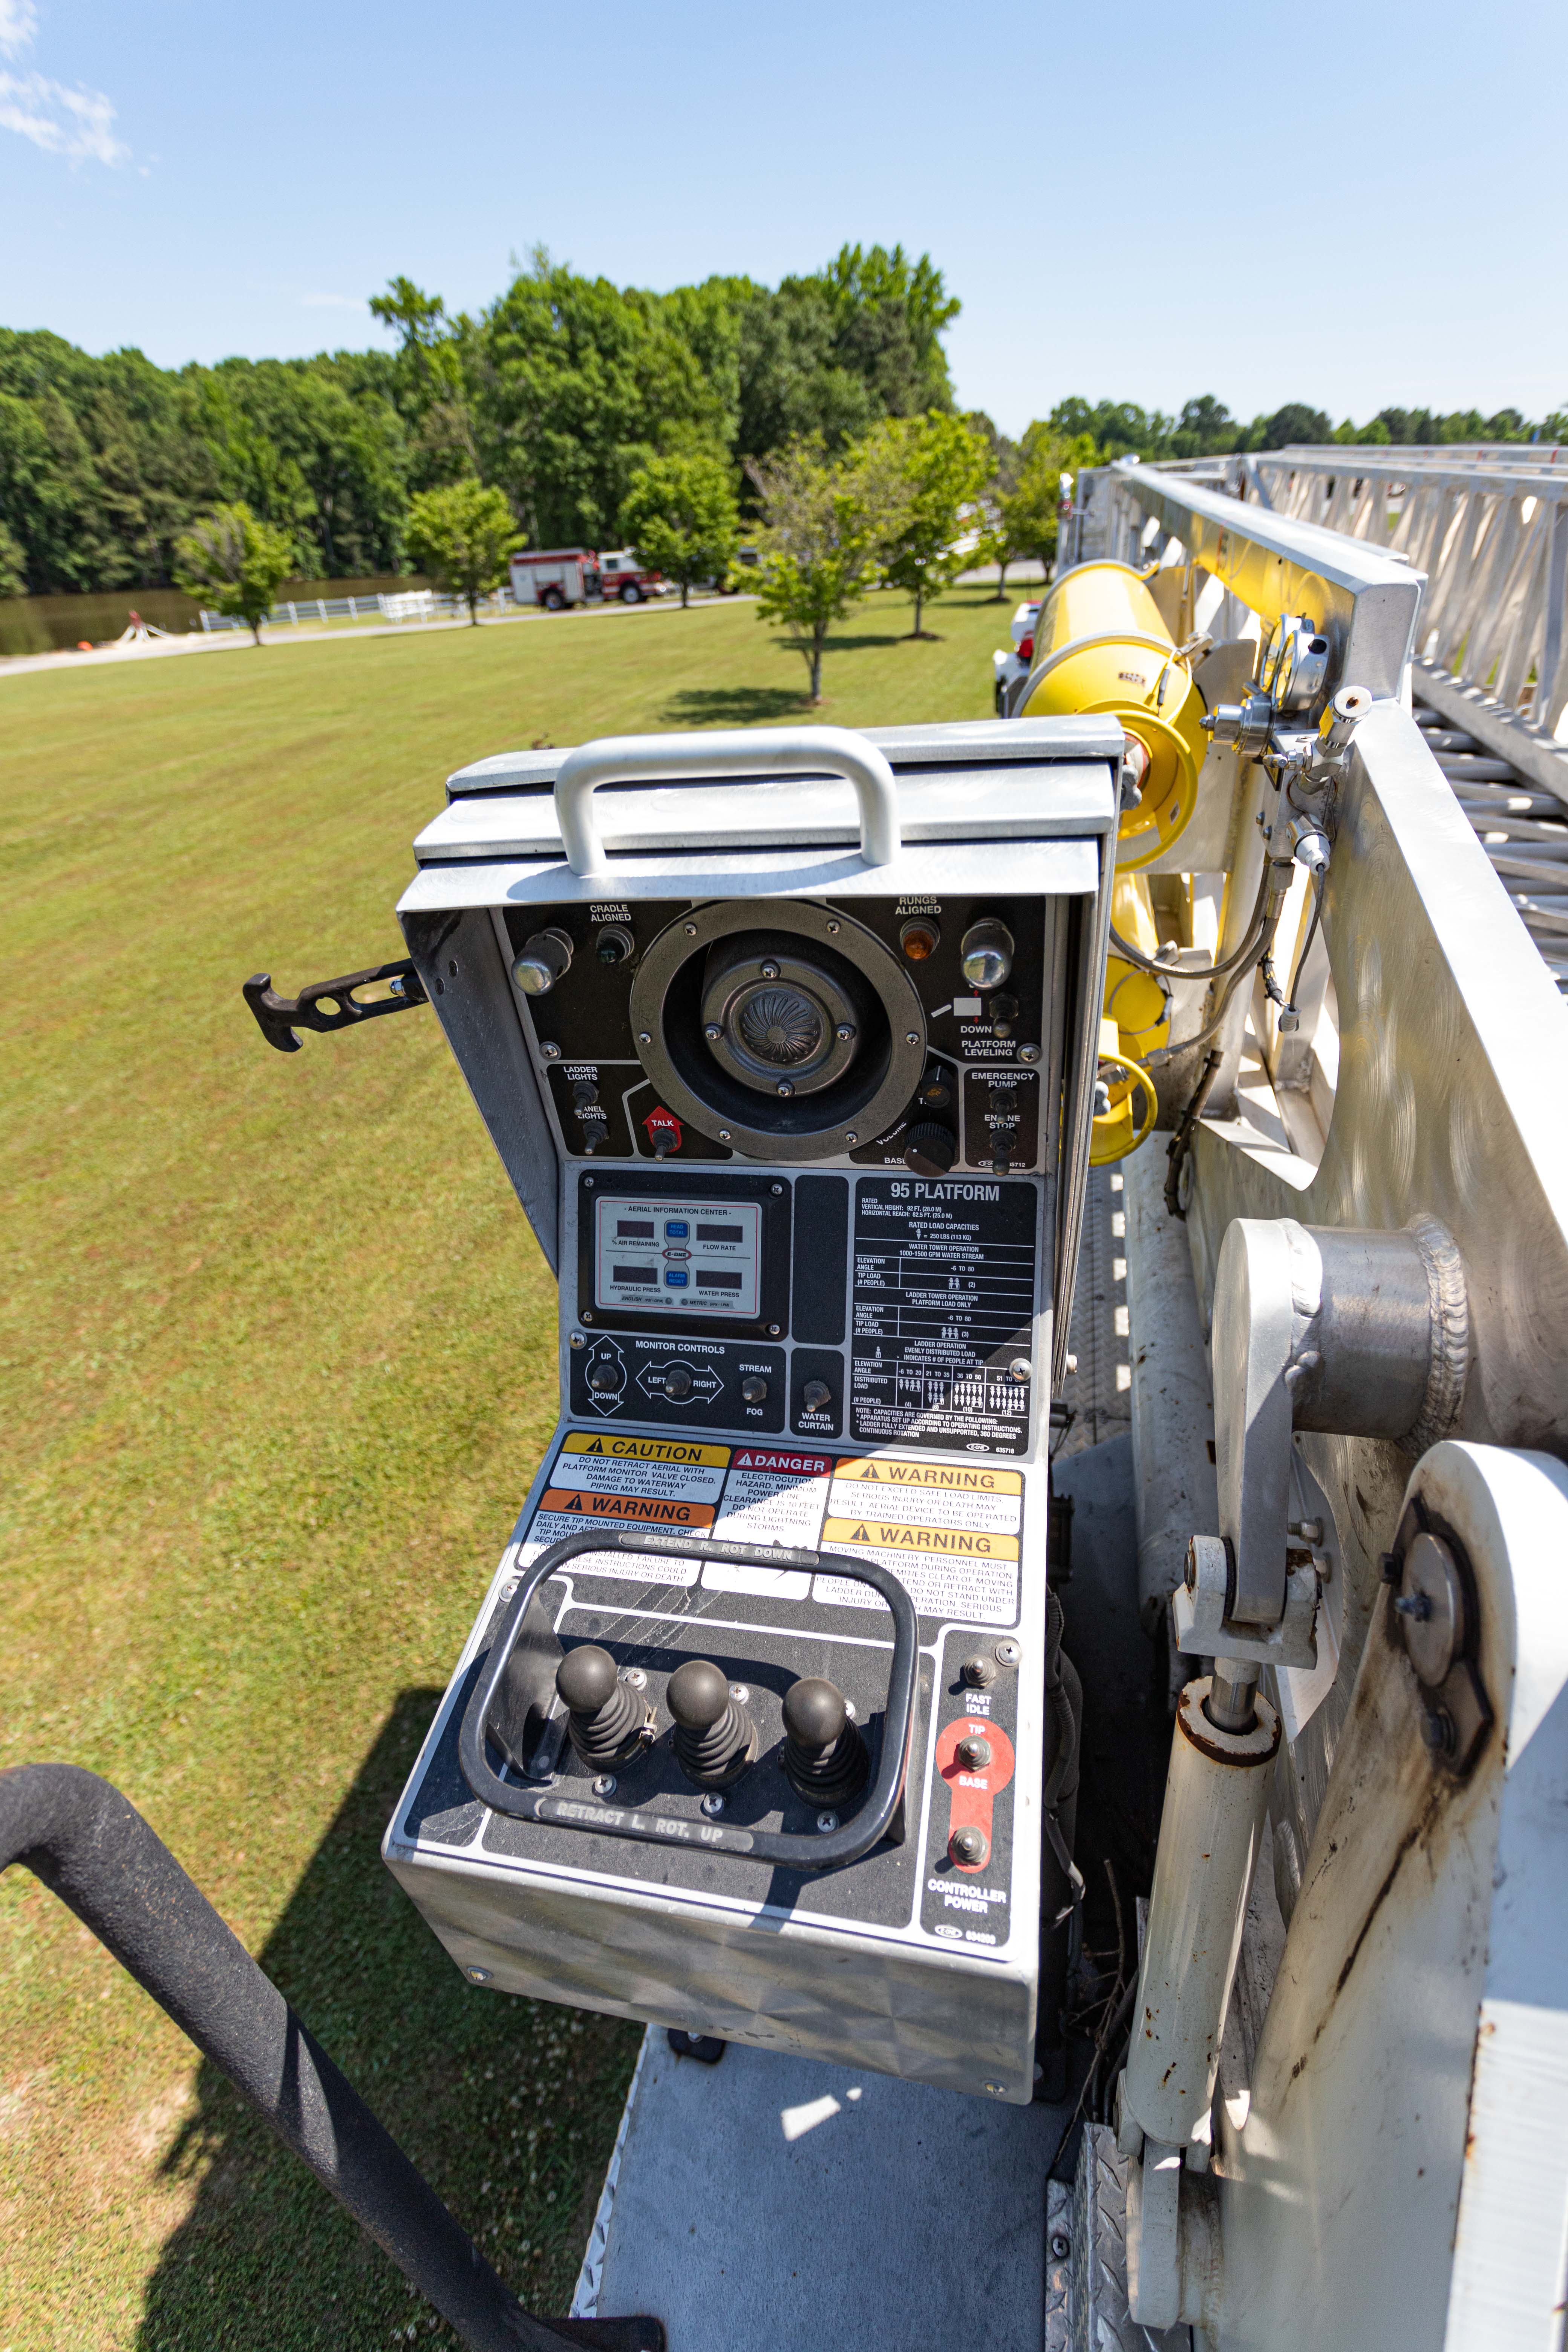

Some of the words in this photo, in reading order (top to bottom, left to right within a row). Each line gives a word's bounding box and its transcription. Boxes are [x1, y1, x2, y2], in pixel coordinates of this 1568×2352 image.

[590, 904, 628, 913] CRADLE
[895, 905, 942, 915] ALIGNED
[591, 913, 631, 922] ALIGNED
[891, 1182, 910, 1198] 95
[915, 1183, 1000, 1201] PLATFORM
[636, 1340, 675, 1351] MONITOR
[677, 1343, 725, 1354] CONTROLS
[739, 1364, 772, 1373] STREAM
[693, 1380, 717, 1388] RIGHT
[594, 1392, 617, 1400] DOWN
[802, 1412, 830, 1422] WATER
[873, 1409, 903, 1417] CAPACITIES
[965, 1416, 998, 1425] FOLLOWING::
[798, 1421, 834, 1431] CURTAIN
[612, 1441, 702, 1461] CAUTION
[611, 1460, 651, 1469] RETRACT
[651, 1464, 681, 1472] AERIAL
[684, 1467, 705, 1475] WITH
[755, 1455, 825, 1472] DANGER
[562, 1463, 607, 1473] PLATFORM
[608, 1467, 648, 1477] MONITOR
[652, 1472, 678, 1480] VALVE
[680, 1475, 715, 1484] CLOSED.
[586, 1473, 622, 1483] DAMAGE
[638, 1479, 686, 1489] WATERWAY
[889, 1467, 994, 1488] WARNING
[590, 1482, 619, 1491] PIPING
[640, 1487, 675, 1497] RESULT.
[736, 1480, 773, 1489] HAZARD.
[776, 1484, 816, 1493] MINIMUM
[593, 1497, 691, 1521] WARNING
[538, 1513, 570, 1523] SECURE
[585, 1519, 625, 1528] MOUNTED
[626, 1523, 675, 1534] EQUIPMENT.
[677, 1529, 706, 1538] CHECK
[866, 1511, 904, 1520] TRAINED
[906, 1515, 962, 1527] OPERATORS
[880, 1527, 991, 1553] WARNING
[644, 1536, 692, 1550] EXTEND
[700, 1542, 712, 1551] R.
[721, 1544, 746, 1556] ROT
[754, 1548, 792, 1561] DOWN
[966, 1693, 992, 1705] FAST
[966, 1703, 990, 1715] IDLE
[968, 1724, 986, 1735] TIP
[959, 1775, 988, 1790] BASE
[556, 1802, 623, 1825] RETRACT
[631, 1815, 644, 1830] L.
[655, 1820, 689, 1838] ROT.
[700, 1826, 723, 1843] UP
[928, 1878, 1006, 1903] CONTROLLER
[945, 1898, 988, 1914] POWER
